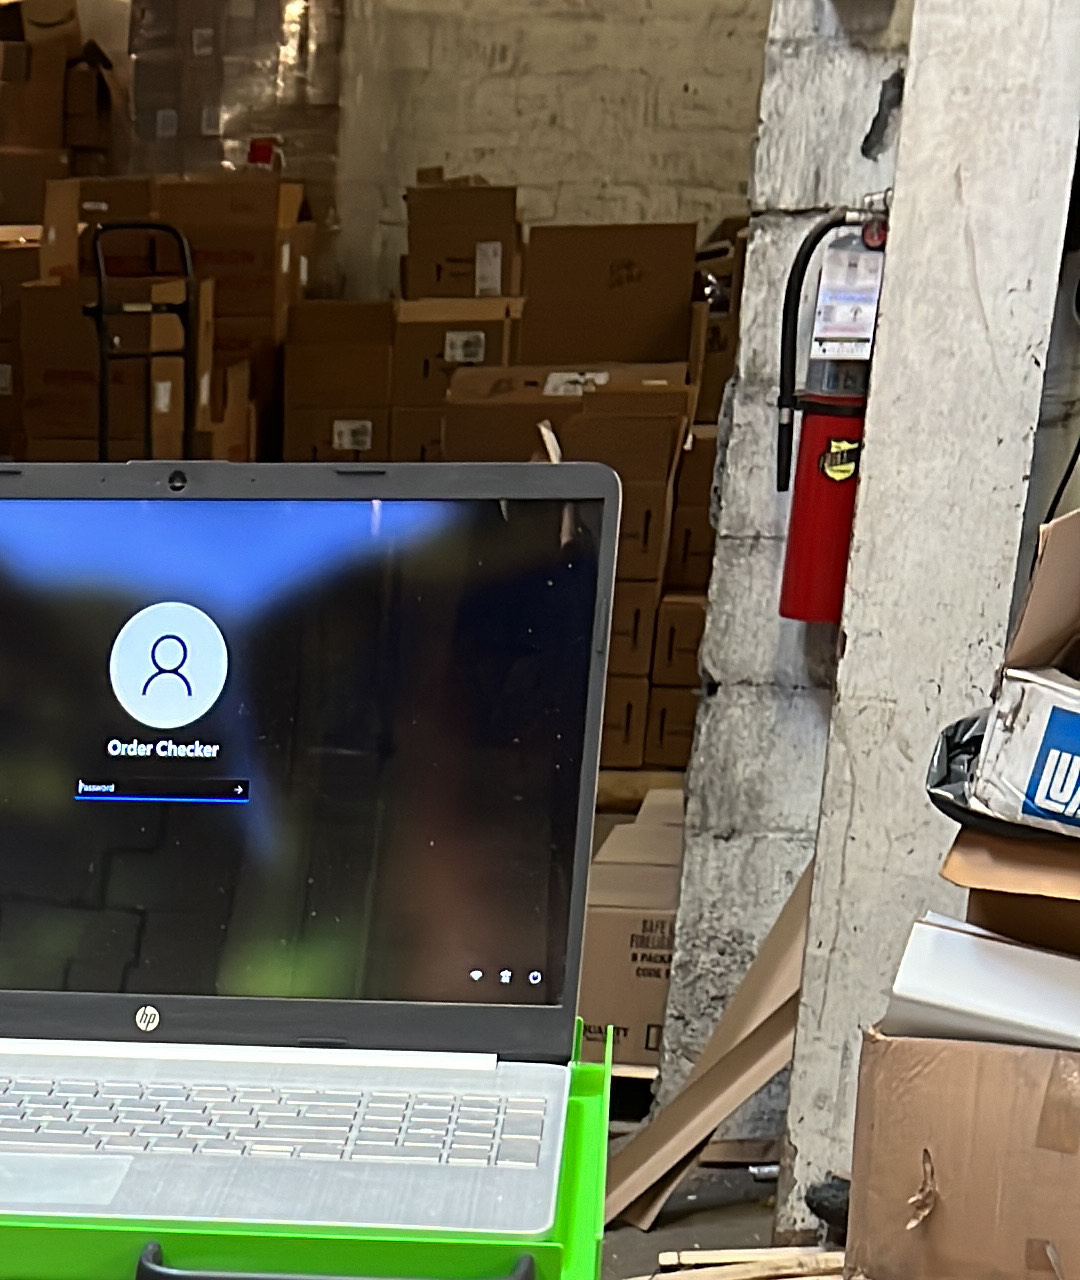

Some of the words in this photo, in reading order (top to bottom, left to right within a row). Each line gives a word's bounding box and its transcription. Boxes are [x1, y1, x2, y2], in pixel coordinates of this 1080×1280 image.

[107, 738, 154, 757] Order
[156, 739, 220, 758] Checker
[137, 1006, 159, 1031] hp
